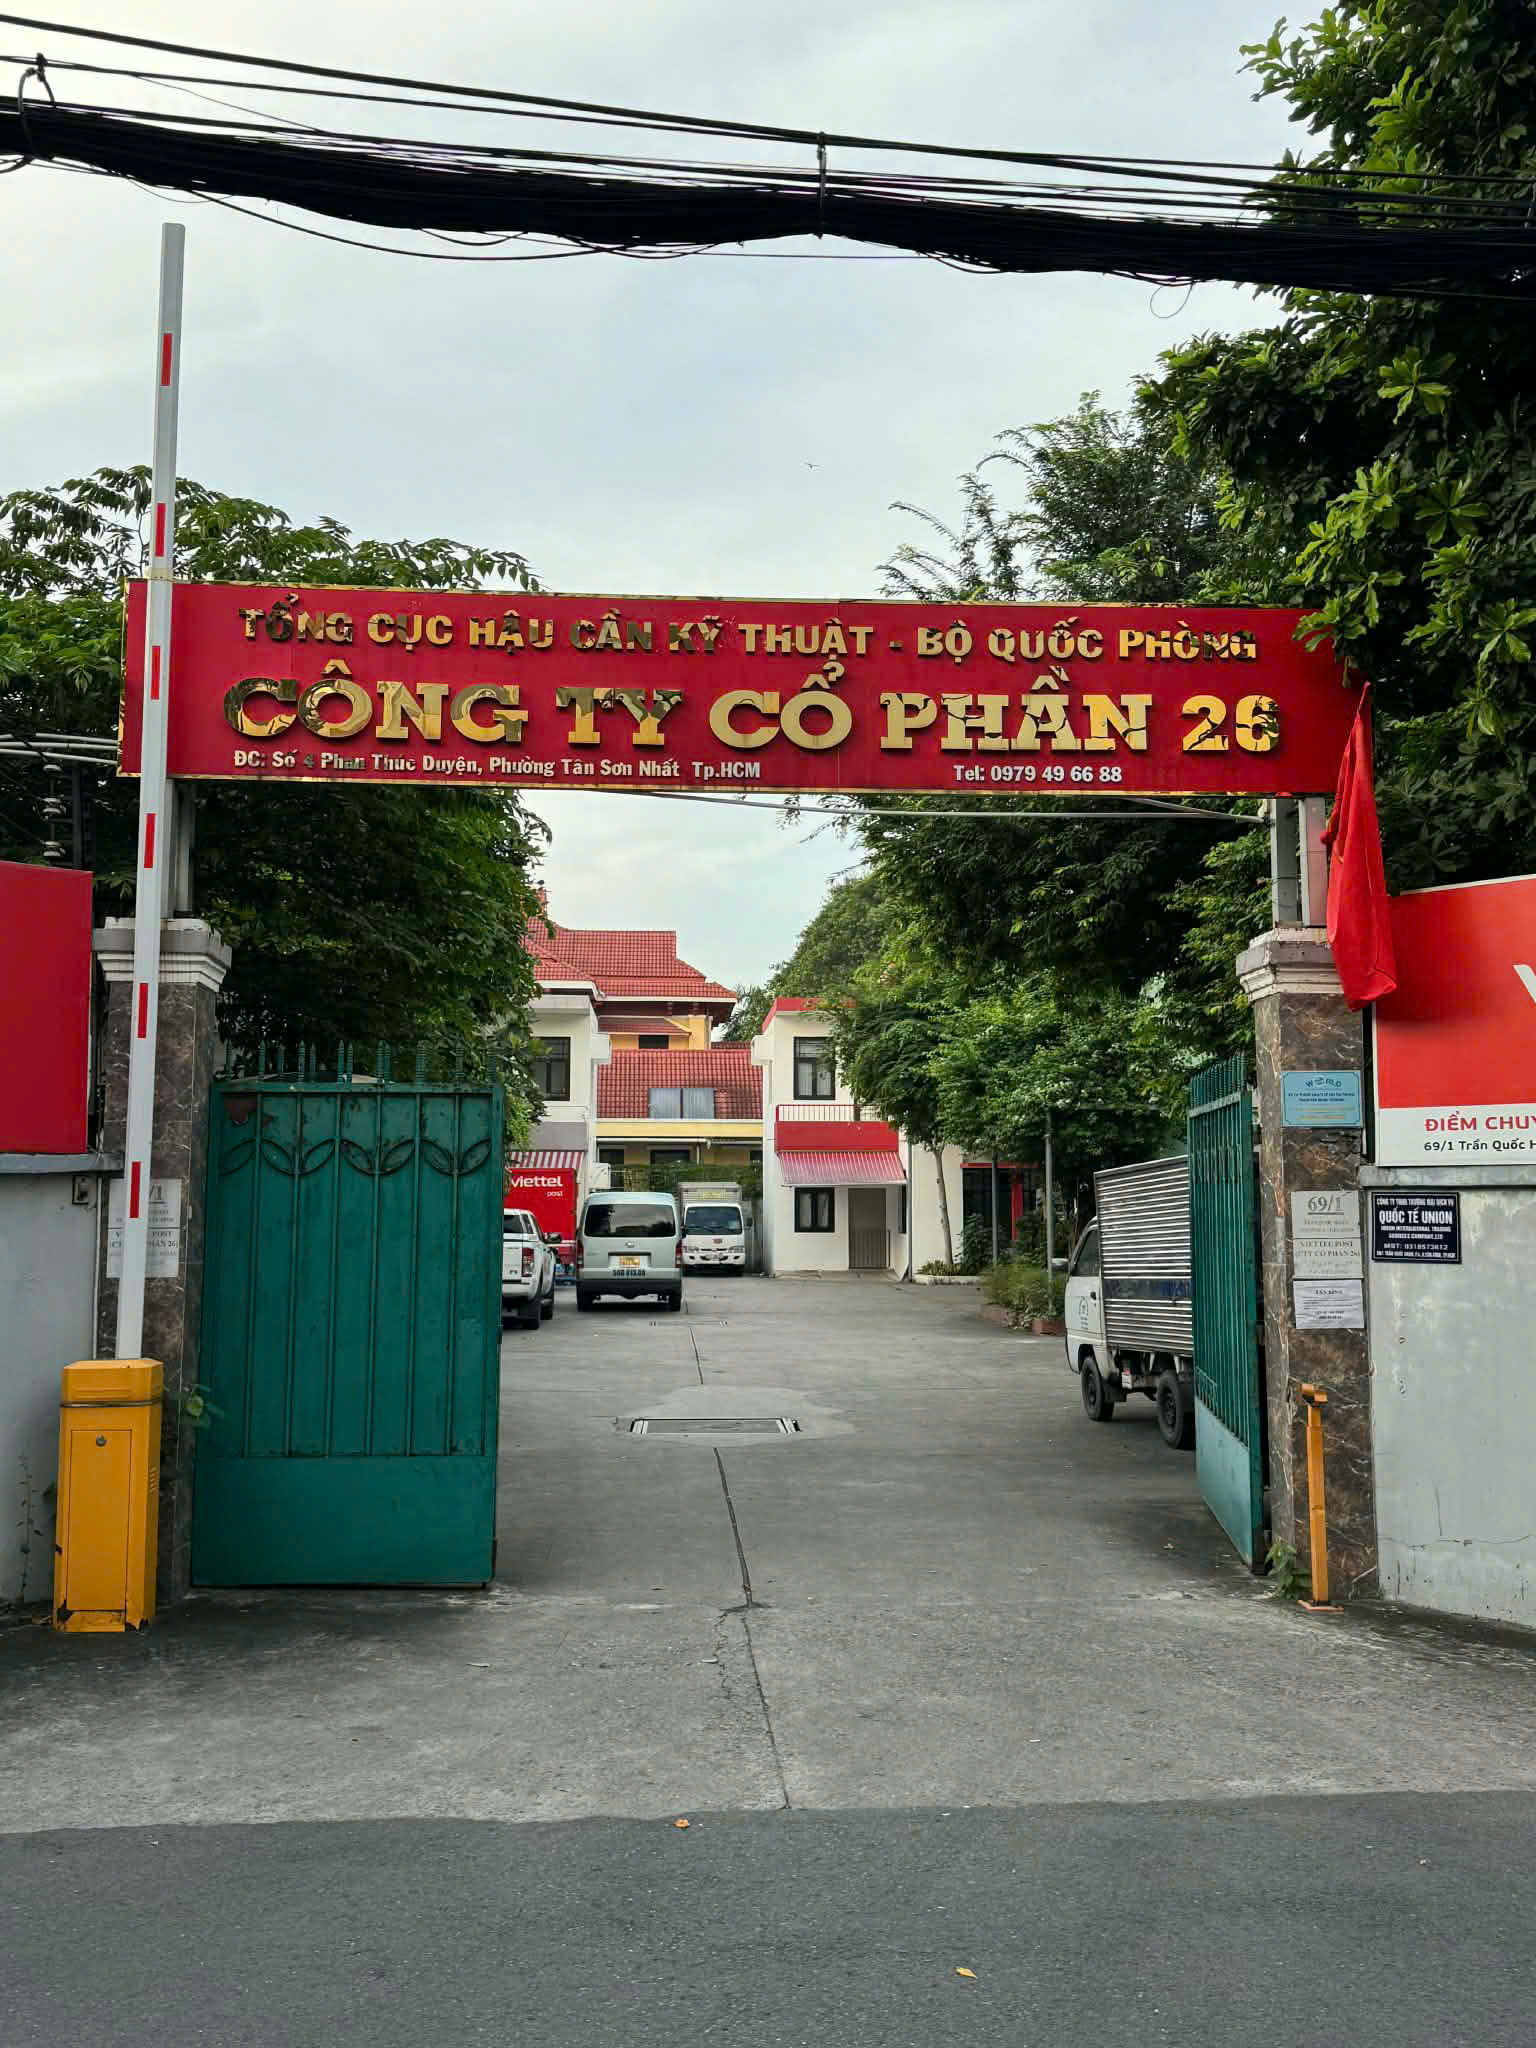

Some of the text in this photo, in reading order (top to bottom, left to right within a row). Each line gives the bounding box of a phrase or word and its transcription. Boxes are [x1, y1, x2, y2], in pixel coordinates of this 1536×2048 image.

[239, 592, 354, 644] TỔNG
[368, 612, 454, 652] CỤC
[469, 609, 554, 655] HẬU
[569, 608, 653, 651] CẦN
[668, 614, 721, 654] KỸ
[738, 617, 874, 661] THUẬT
[916, 619, 974, 665] BỘ
[987, 616, 1105, 662] QUỐC
[1118, 620, 1258, 660] PHÒNG
[223, 658, 1282, 753] CÔNG TY CỔ PHẦN 26
[233, 749, 266, 768] ĐC:
[271, 749, 299, 768] Số
[320, 752, 366, 770] Phan
[371, 752, 417, 772] Thúc
[421, 754, 483, 776] Duyện,
[489, 755, 556, 777] Phường
[561, 758, 595, 776] Tân
[600, 758, 633, 777] Sơn
[639, 757, 680, 778] Nhất
[692, 760, 761, 780] Tp.HCM
[953, 764, 1123, 783] Tel: 0979 49 66 88
[1424, 1110, 1478, 1132] ĐIỂM
[1423, 1140, 1454, 1153] 69/1
[1492, 1137, 1526, 1152] Quốc
[511, 1175, 564, 1188] viettel
[546, 1190, 564, 1198] post
[1307, 1194, 1344, 1212] 69/1
[1379, 1205, 1453, 1225] QUỐC TẾ UNION
